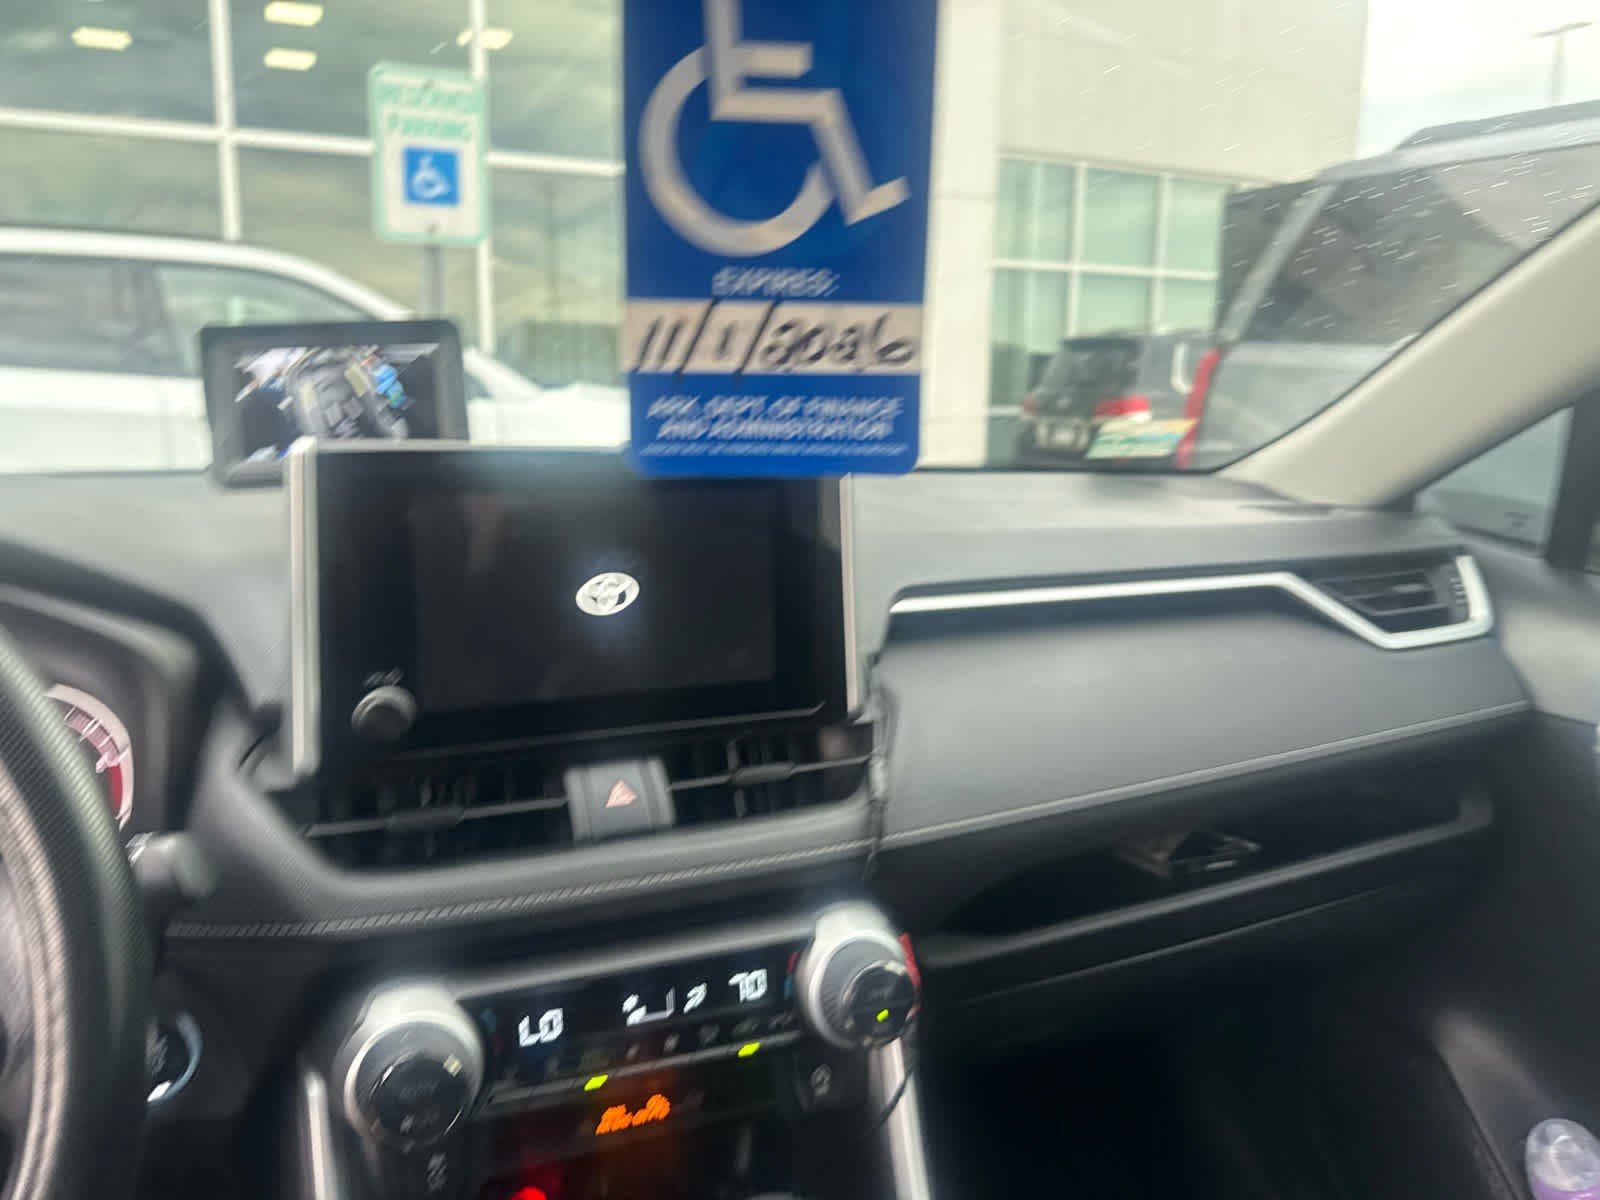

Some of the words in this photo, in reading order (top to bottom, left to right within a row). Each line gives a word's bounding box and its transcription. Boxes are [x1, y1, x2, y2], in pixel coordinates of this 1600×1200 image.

[712, 267, 839, 296] EXPIRES:
[648, 395, 700, 418] ARK.
[767, 395, 803, 417] OF
[803, 395, 903, 416] FINANCE
[656, 417, 708, 440] AND
[709, 417, 894, 440] ADMINISTRATION
[728, 968, 768, 1003] 70
[517, 1007, 564, 1048] LO
